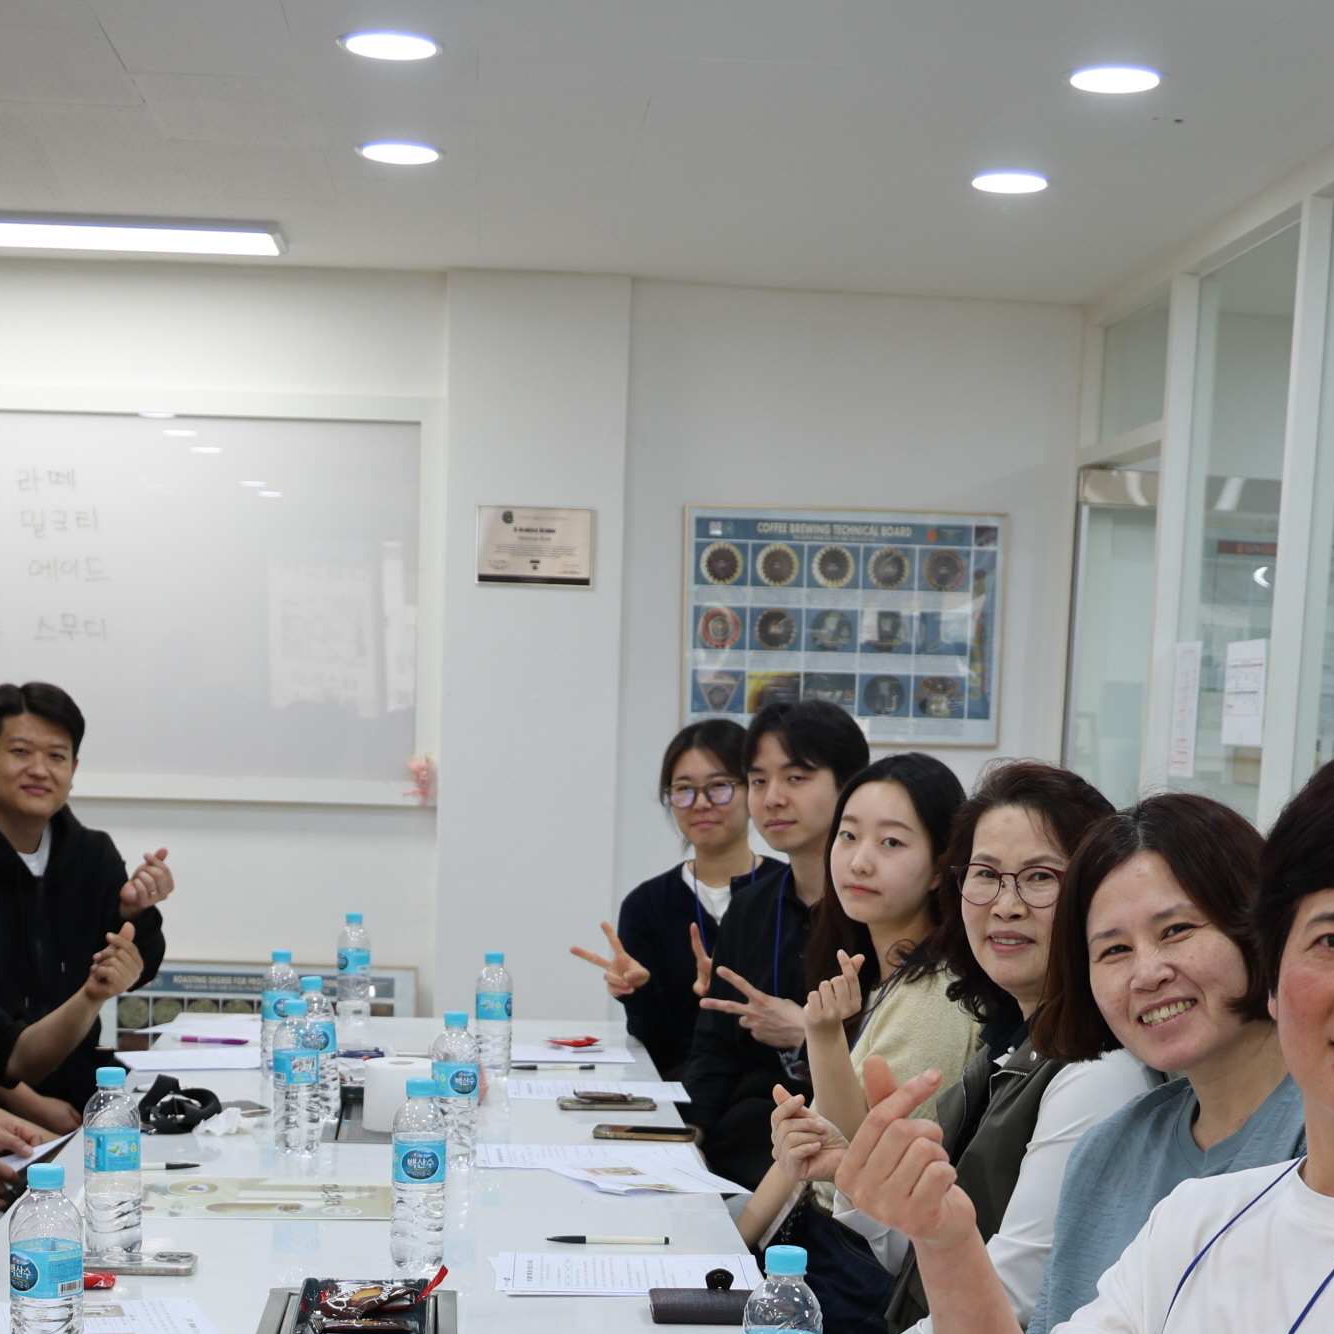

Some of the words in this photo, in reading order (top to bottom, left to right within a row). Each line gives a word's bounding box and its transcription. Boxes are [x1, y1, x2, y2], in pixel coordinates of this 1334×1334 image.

[18, 467, 76, 493] 라떼
[20, 508, 98, 539] 밀크티
[757, 522, 786, 533] COFFEE
[789, 523, 830, 535] BREWING
[833, 524, 878, 536] TECHNICAL
[881, 525, 912, 537] BOARD
[28, 557, 110, 582] 에이드
[34, 614, 107, 642] 스무디
[173, 975, 206, 985] ROASTING
[208, 976, 232, 985] DEGREE
[234, 976, 246, 985] FOR
[455, 1077, 474, 1085] 백산수
[407, 1158, 434, 1169] 백산수
